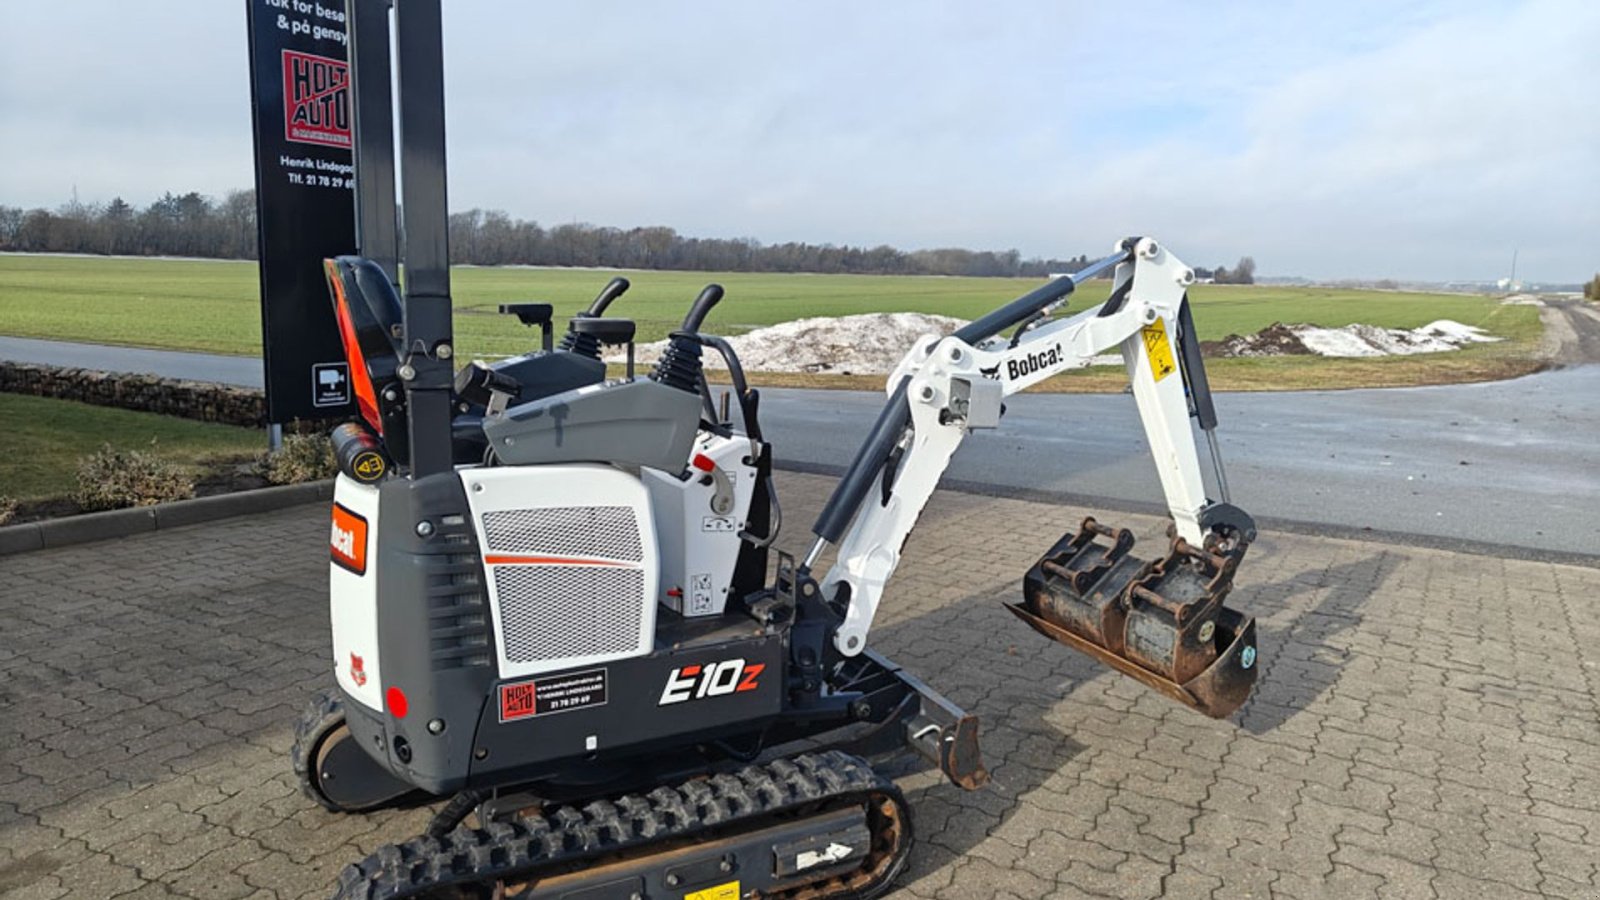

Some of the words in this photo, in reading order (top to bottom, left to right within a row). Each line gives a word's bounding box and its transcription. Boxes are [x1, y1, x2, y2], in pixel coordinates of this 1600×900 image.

[292, 0, 313, 14] for
[277, 14, 289, 30] &
[292, 19, 311, 35] på
[292, 57, 347, 101] HOLT
[292, 87, 348, 130] AUTO
[280, 156, 315, 169] Henrik
[306, 174, 316, 185] 21
[318, 175, 330, 187] 78
[332, 177, 343, 188] 29
[506, 684, 532, 704] HOLT
[506, 692, 533, 712] AUTO
[560, 698, 569, 707] 78
[570, 696, 580, 705] 29
